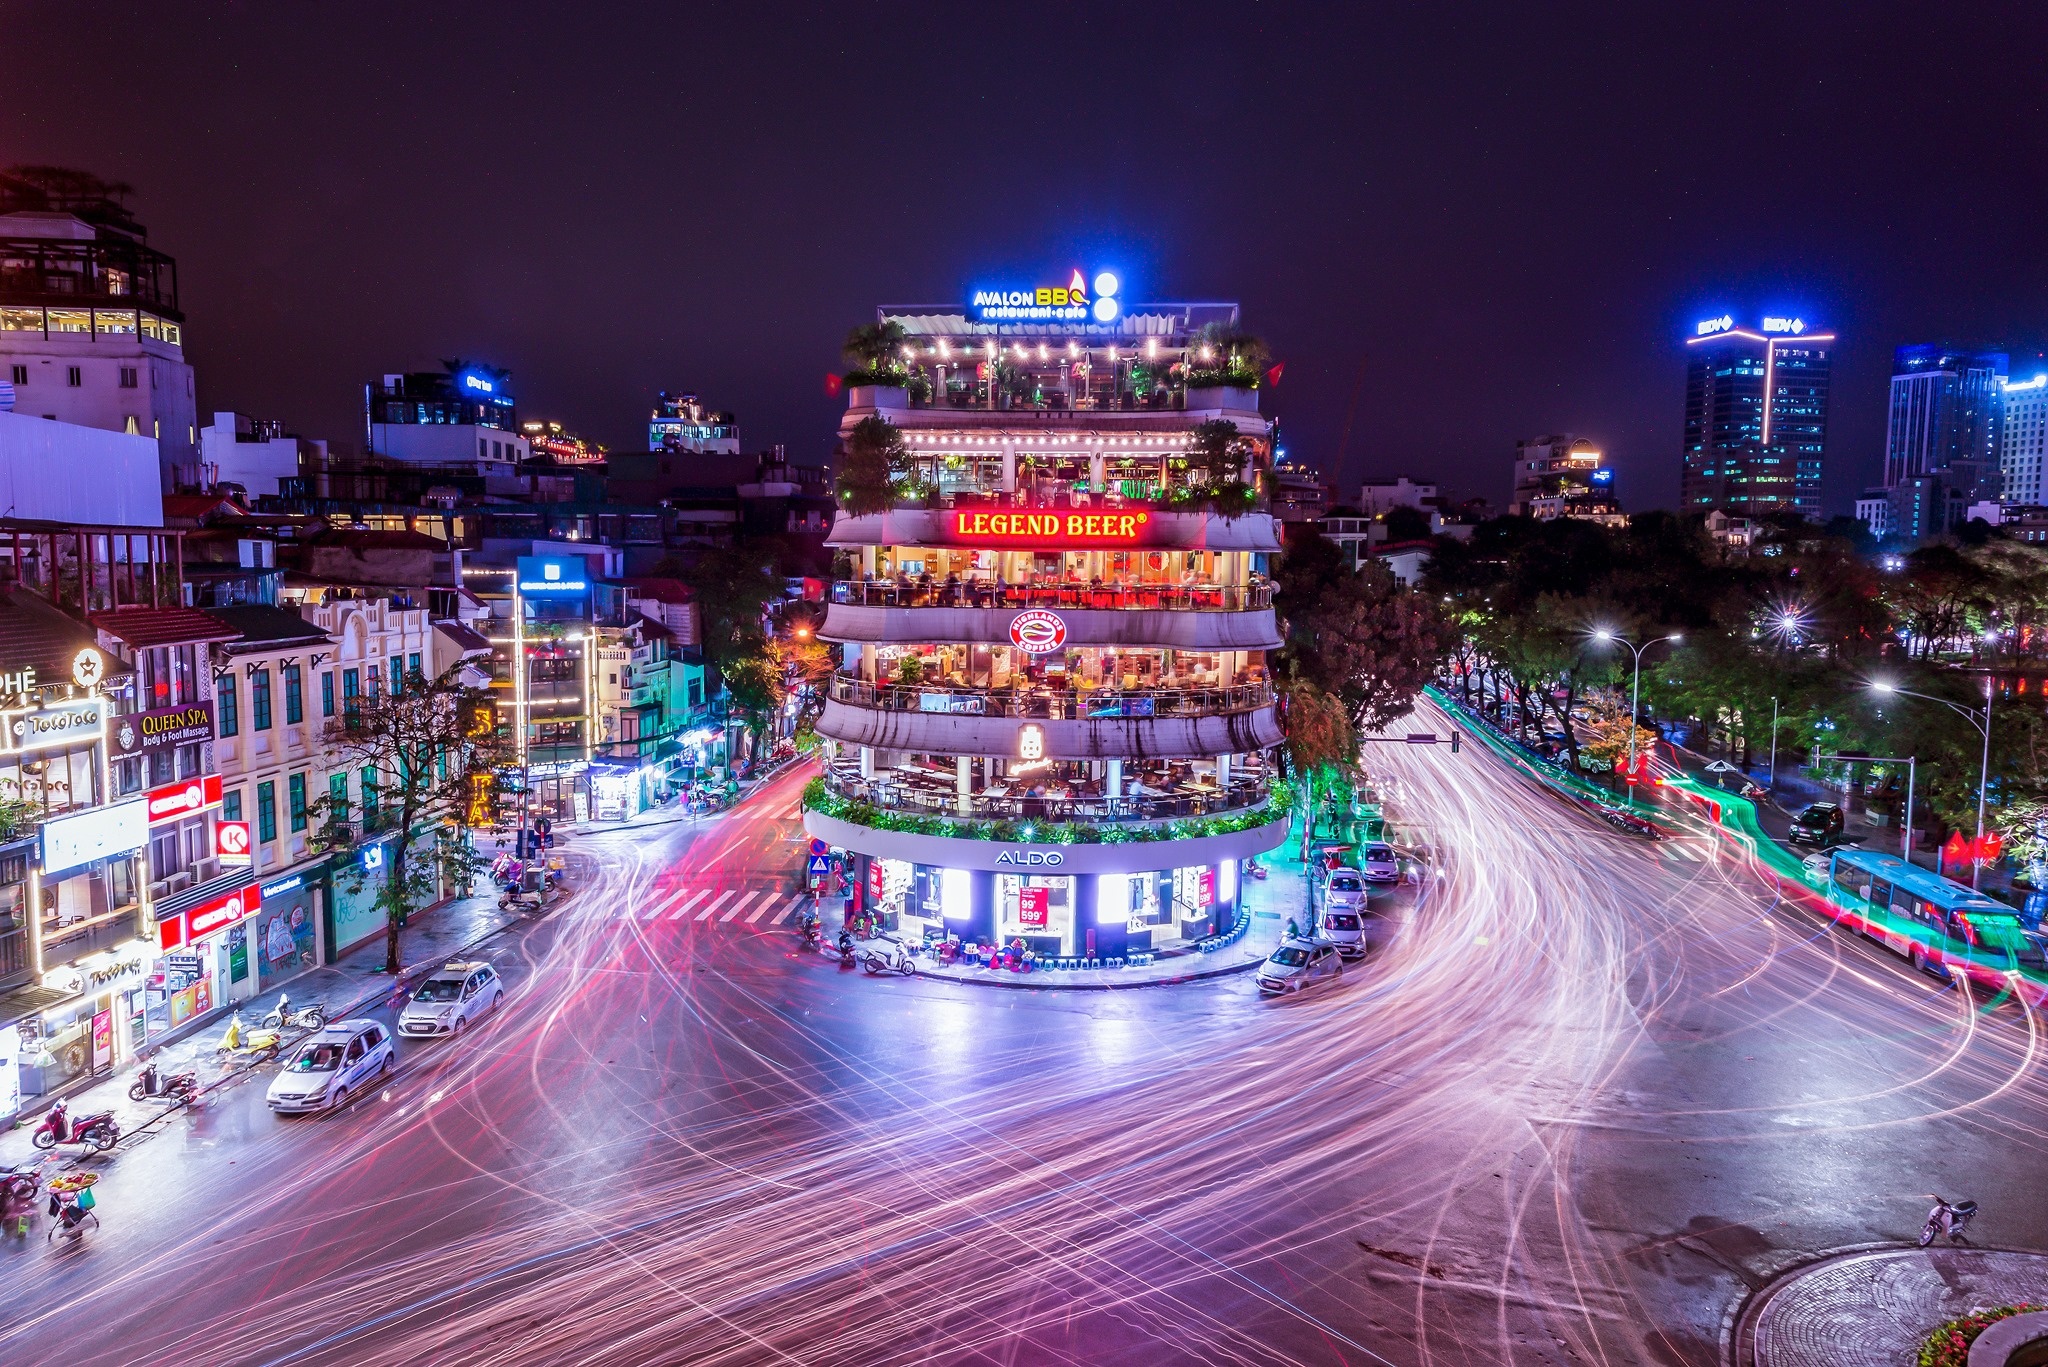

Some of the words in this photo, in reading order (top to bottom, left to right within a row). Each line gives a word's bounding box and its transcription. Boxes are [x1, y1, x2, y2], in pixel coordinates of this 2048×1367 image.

[973, 291, 1034, 306] AVALON
[1036, 279, 1090, 306] BBQ
[958, 513, 1060, 536] LEGEND
[1012, 611, 1063, 631] HIGHLANDS
[1018, 640, 1058, 652] COFFEE
[0, 666, 36, 695] HÊ
[142, 712, 185, 735] QUEEN
[187, 708, 208, 726] SPA
[143, 734, 161, 747] Body
[161, 734, 167, 742] &
[168, 730, 182, 741] Foot
[183, 726, 209, 738] Massage
[229, 832, 244, 849] K
[995, 850, 1064, 867] ALDO
